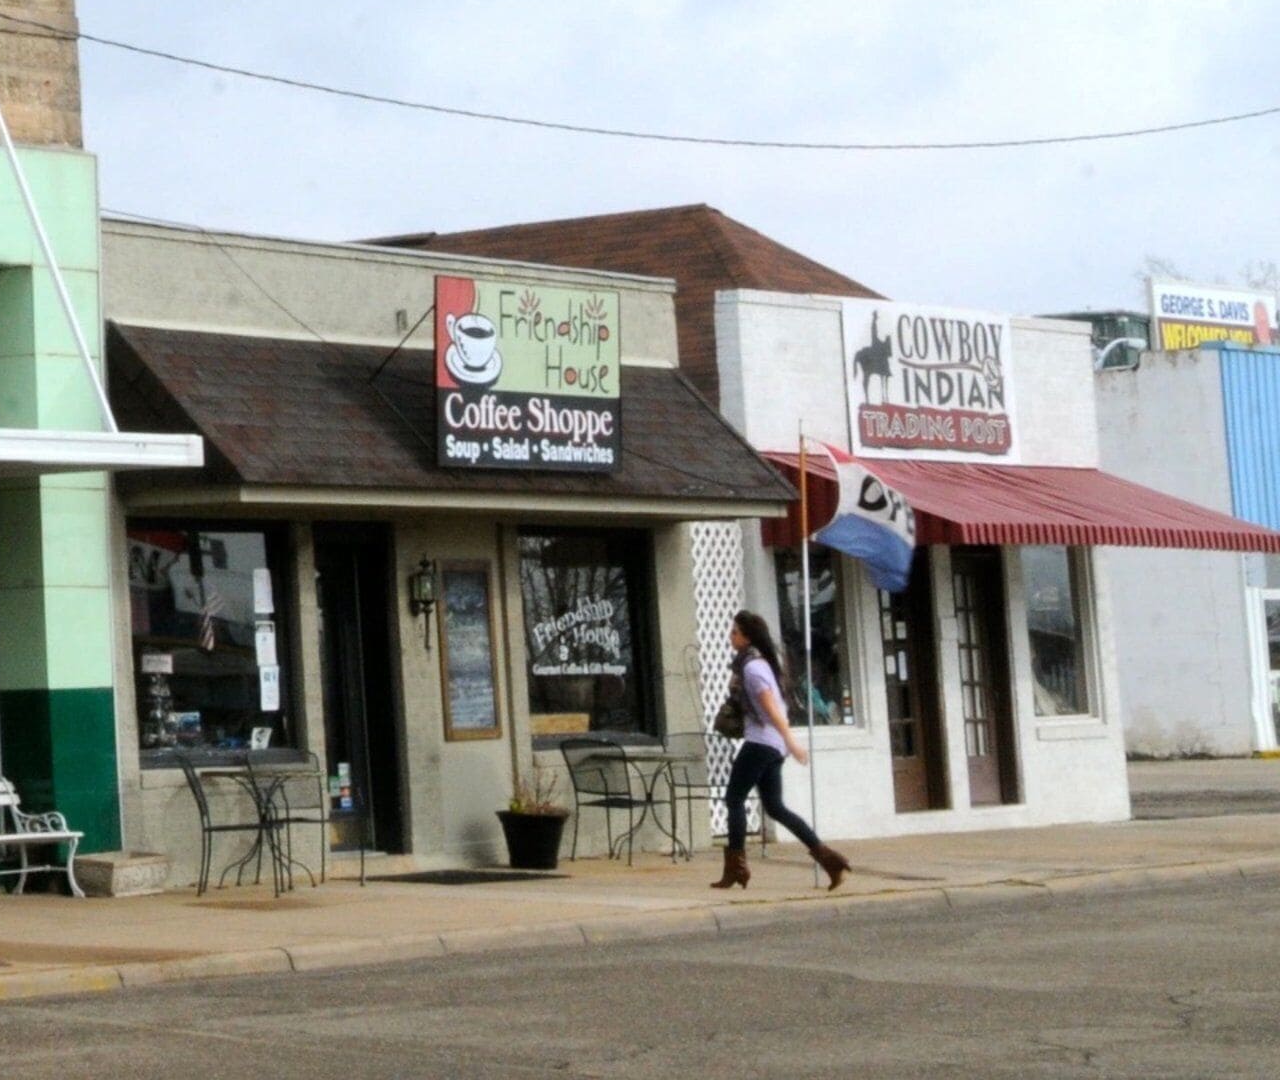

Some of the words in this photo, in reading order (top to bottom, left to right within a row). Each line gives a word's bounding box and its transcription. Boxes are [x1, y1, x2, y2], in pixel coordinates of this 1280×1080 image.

[499, 290, 610, 360] Friendship
[1161, 294, 1205, 317] GEORGE
[897, 314, 1003, 367] COWBOY
[545, 344, 610, 394] House
[902, 367, 1005, 409] INDIAN
[445, 393, 522, 431] Coffee
[527, 397, 614, 443] Shoppe
[863, 410, 956, 442] TRADING
[960, 417, 1006, 445] POST
[446, 434, 481, 464] Soup
[492, 436, 529, 461] Salad
[540, 438, 614, 464] Sandwiches
